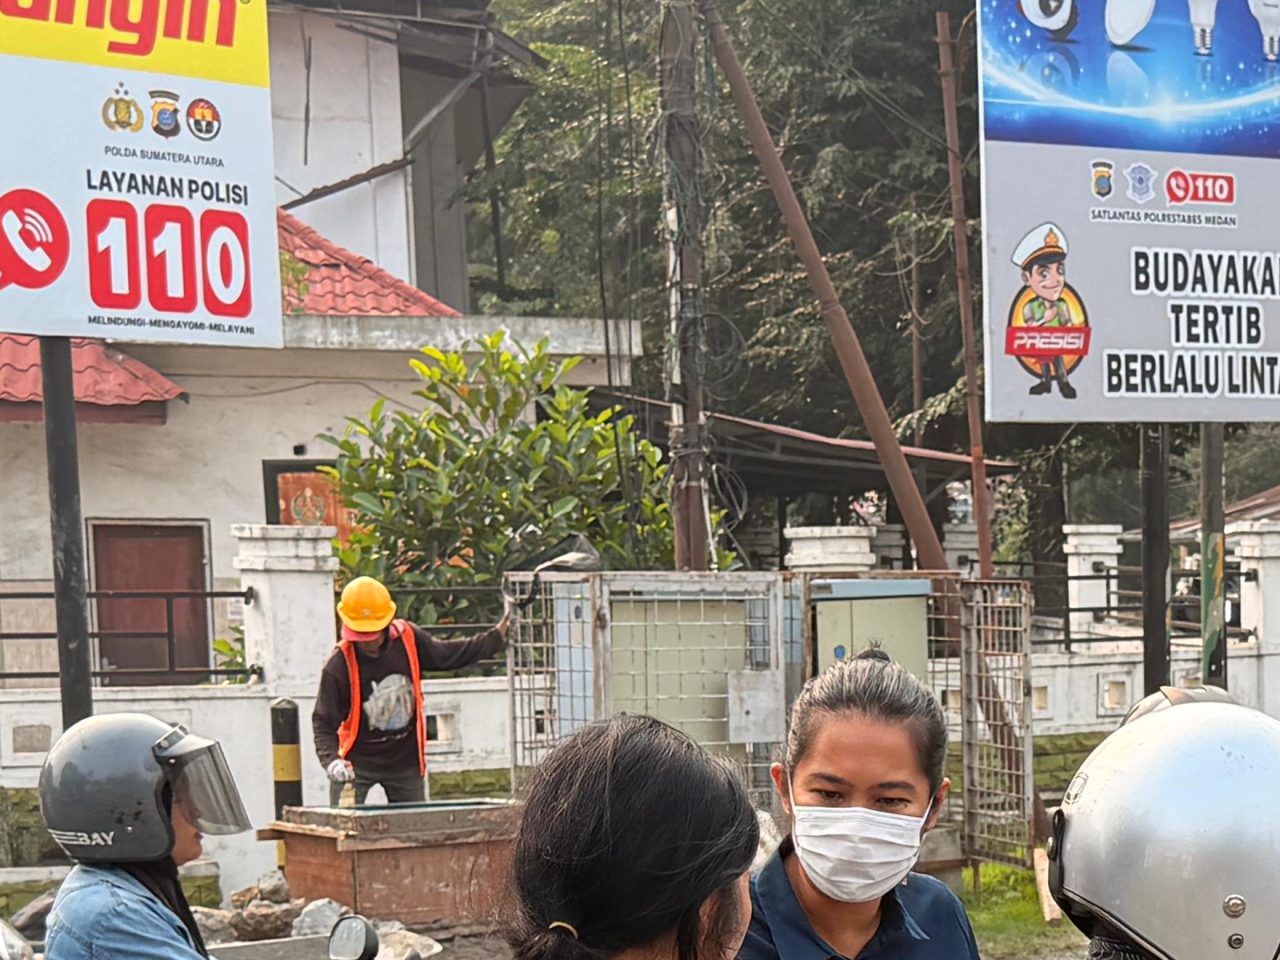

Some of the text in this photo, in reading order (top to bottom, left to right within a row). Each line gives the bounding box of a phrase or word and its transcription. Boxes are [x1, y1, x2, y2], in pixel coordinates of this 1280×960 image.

[104, 145, 225, 168] POLDA SUMATERA UTARA
[86, 169, 249, 206] LAYANAN POLISI
[1195, 177, 1229, 199] 110
[1091, 209, 1237, 226] SATLANTAS POLRESTABES MEDAN
[97, 217, 246, 305] 110
[1170, 303, 1261, 344] TERTIB
[1013, 332, 1085, 349] PRESISI
[1107, 353, 1223, 393] BERLALU
